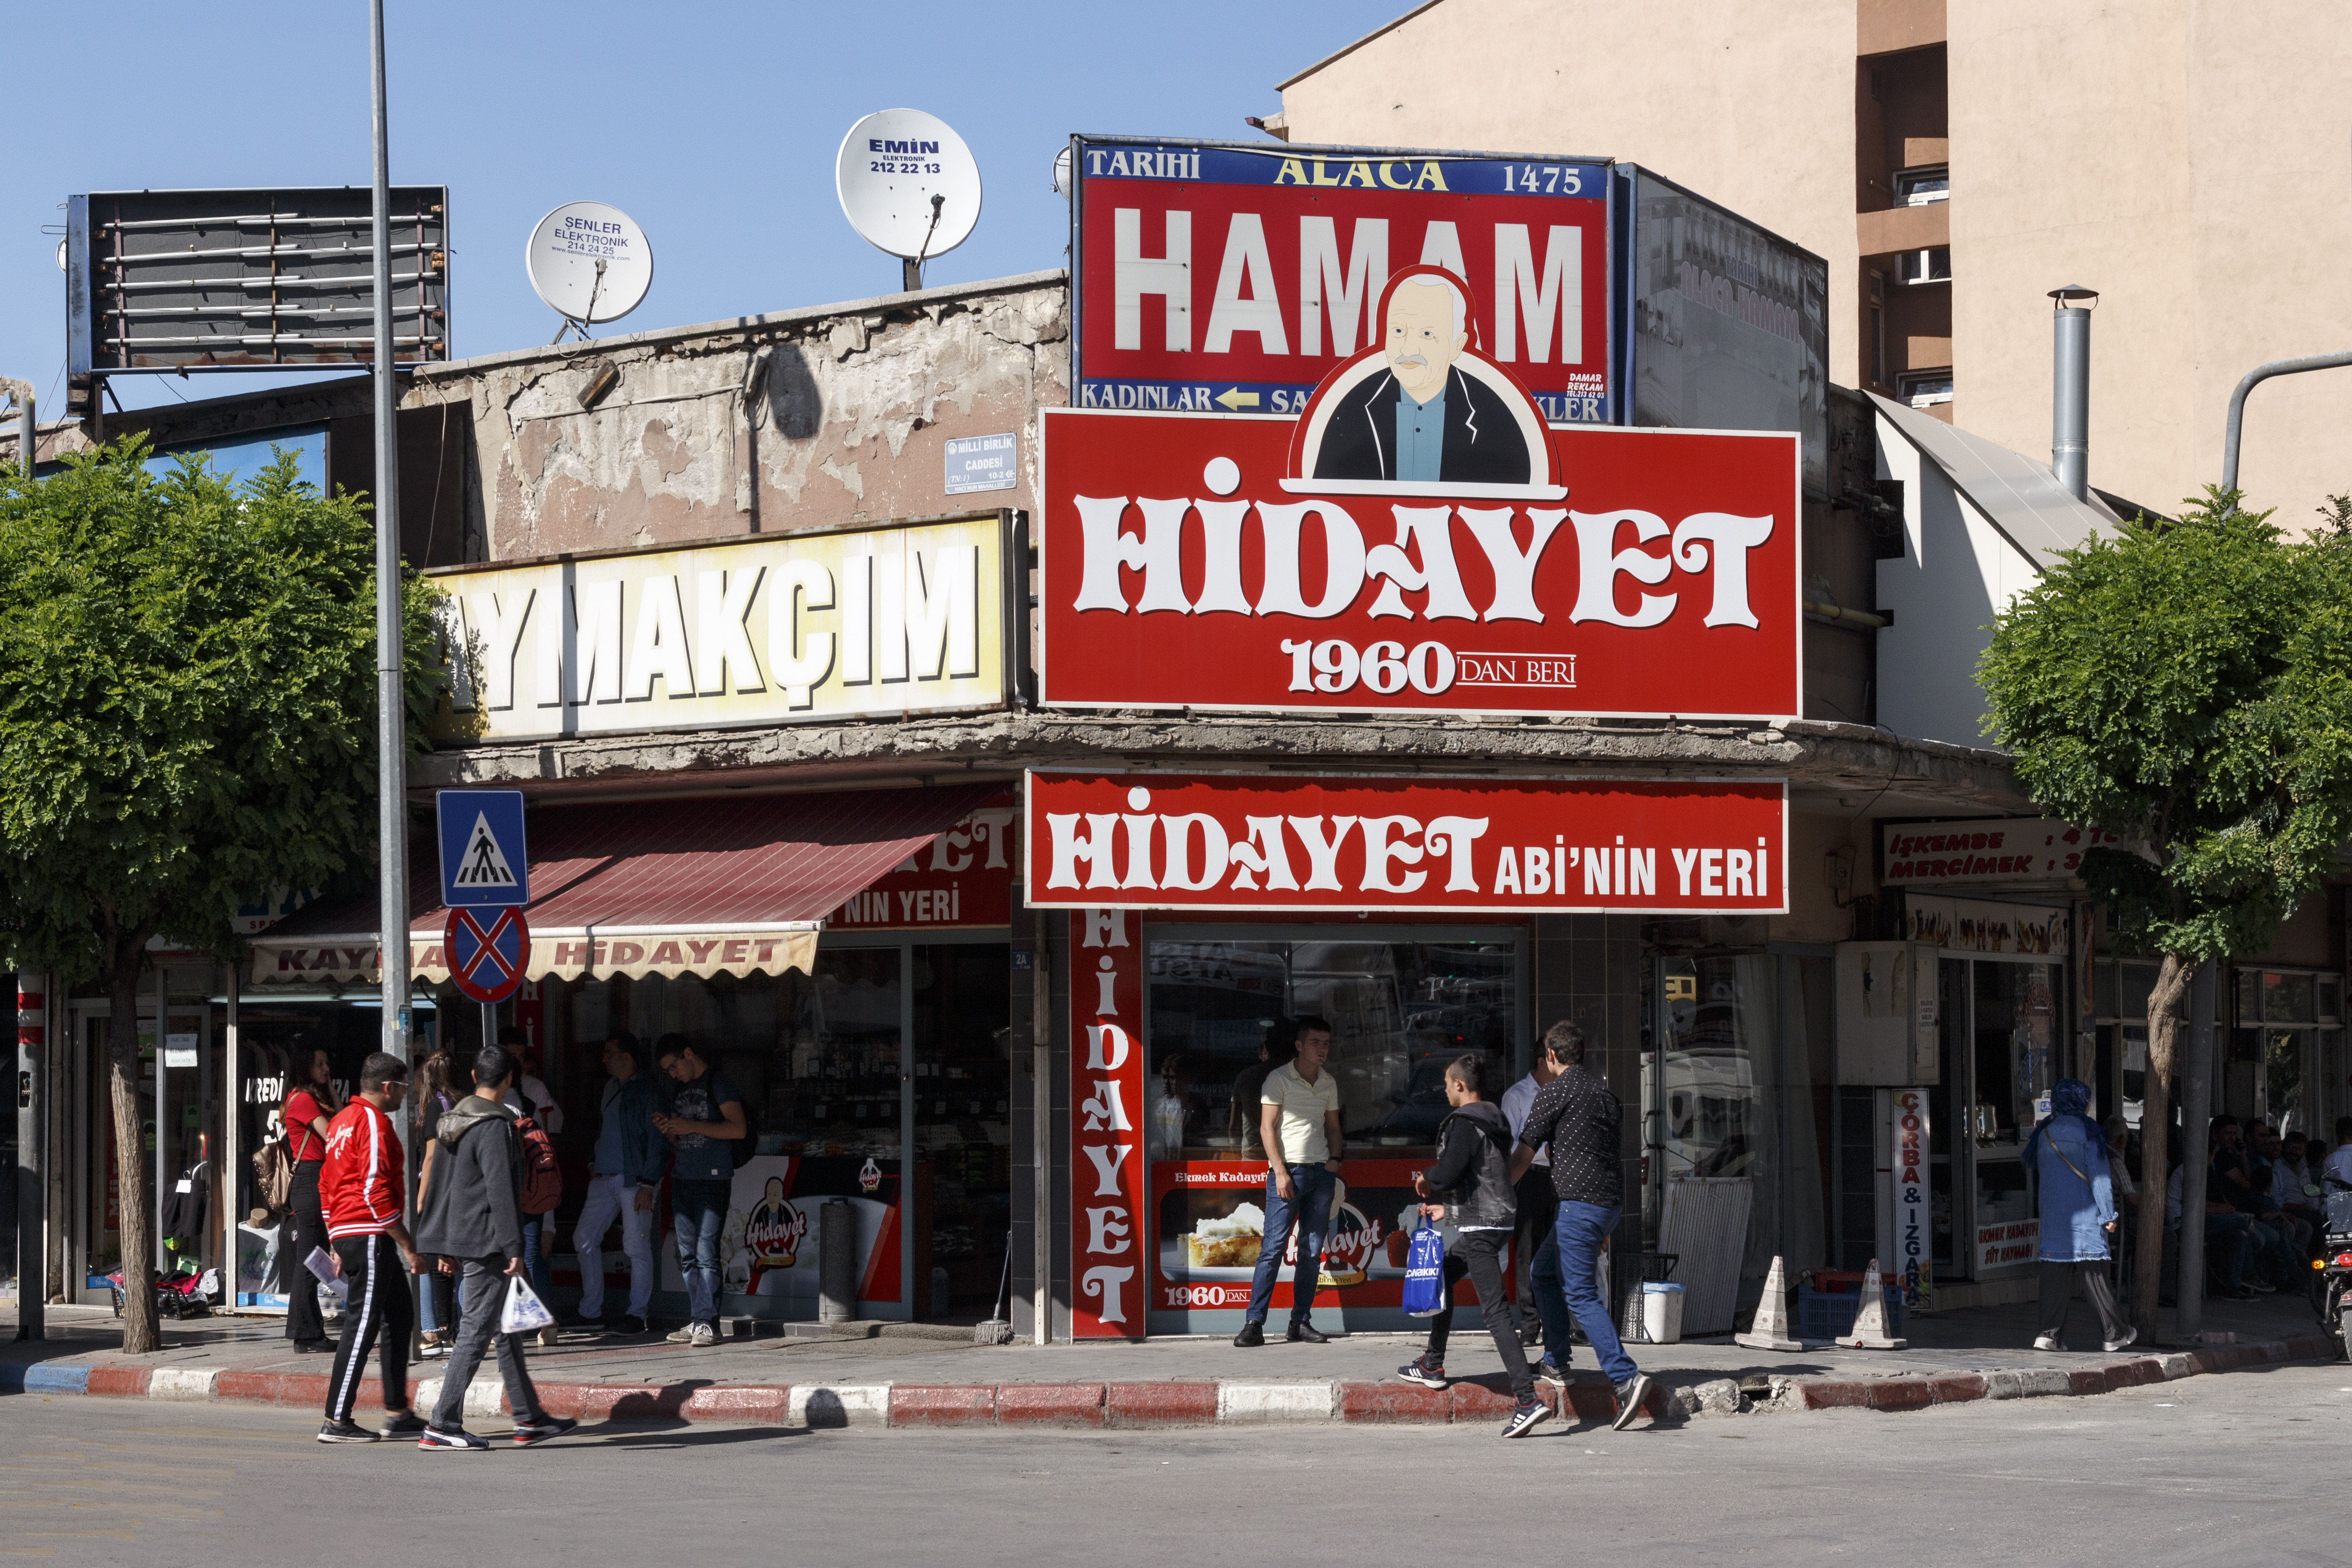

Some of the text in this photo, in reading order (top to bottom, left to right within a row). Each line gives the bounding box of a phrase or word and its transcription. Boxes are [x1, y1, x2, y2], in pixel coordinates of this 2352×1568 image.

[869, 139, 939, 153] EMİN
[871, 161, 941, 174] 212 22 13
[1086, 146, 1582, 195] TARİHİ ALACA 1475
[565, 217, 621, 234] ŞENLER
[555, 228, 628, 247] ELEKTRONİK
[552, 246, 630, 261] www.senlerelektronik.com
[567, 241, 614, 255] 214 24 25
[1567, 382, 1604, 391] REKLAM
[1569, 373, 1602, 382] DAMAR
[1082, 384, 1213, 412] KADINLAR
[958, 436, 1013, 453] MİLLİ BİRLİK
[966, 455, 1003, 471] CADDESİ
[978, 481, 1005, 489] MAHALLESİ
[1073, 456, 1773, 630] HİDAYET
[1527, 654, 1575, 684] BERİ
[1046, 786, 1767, 897] HİDAYET ABİ'NİN YERİ
[1889, 832, 2004, 857] İŞKEMBE
[2062, 828, 2081, 845] 4
[1889, 855, 2032, 878] MERCİMEK
[2063, 852, 2080, 870] 3
[898, 881, 959, 922] YERİ
[1016, 954, 1027, 964] 2A
[245, 1071, 284, 1104] KREDİ
[1901, 1092, 1920, 1184] ÇORBA
[1175, 1172, 1217, 1182] Ekmek
[747, 1214, 806, 1244] Hidayet
[1978, 1226, 2005, 1244] EKMEK
[1286, 1219, 1381, 1262] Hayet
[1985, 1246, 2000, 1265] SÜT
